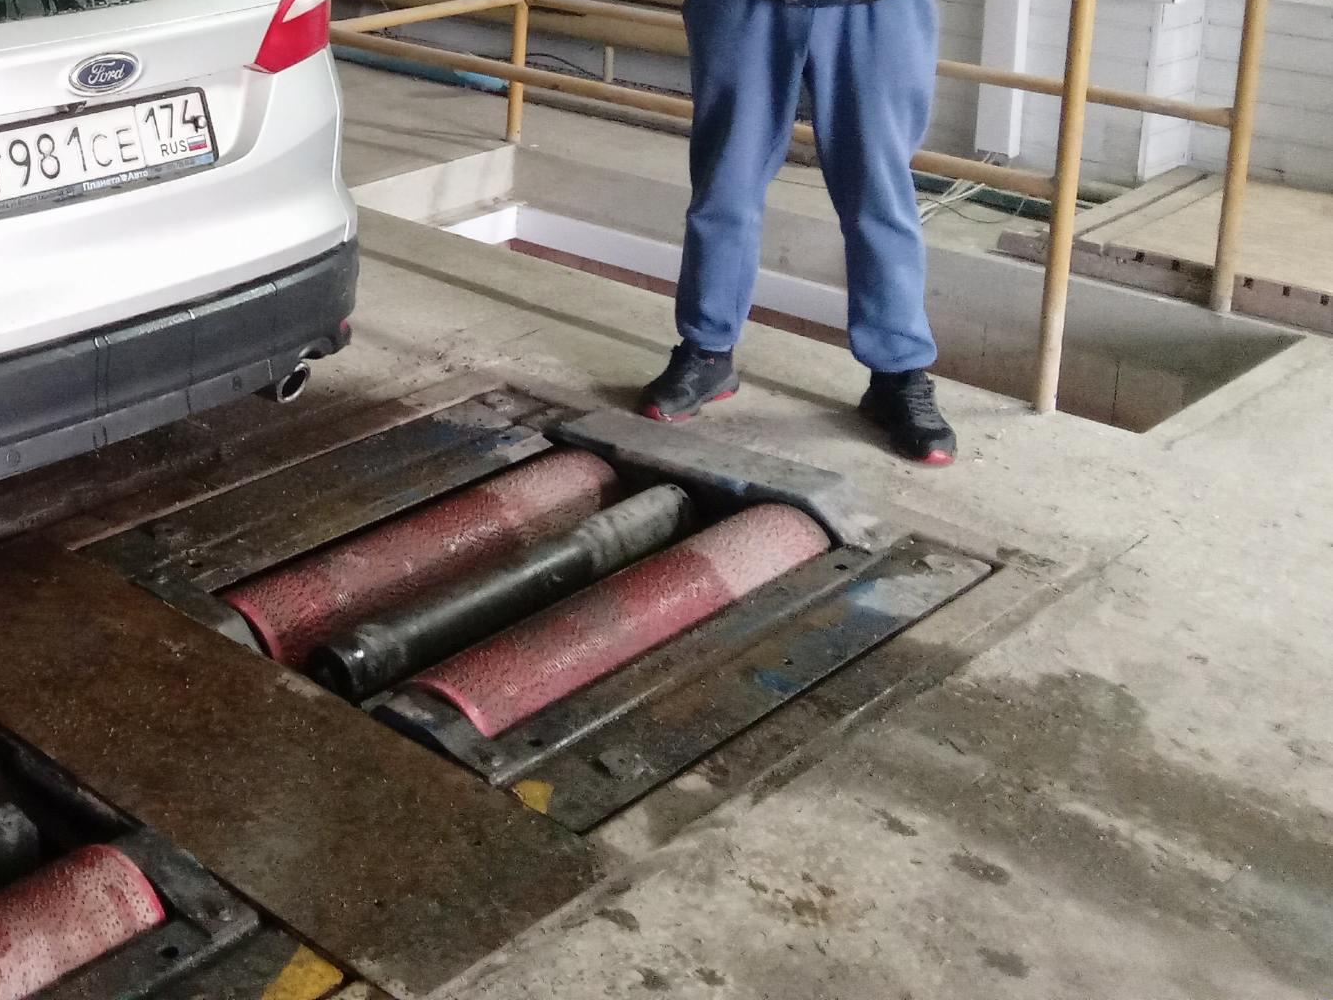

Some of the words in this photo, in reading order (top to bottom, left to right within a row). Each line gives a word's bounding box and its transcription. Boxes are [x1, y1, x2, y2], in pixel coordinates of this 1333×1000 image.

[88, 61, 125, 85] Ford
[145, 98, 200, 142] 174
[160, 140, 188, 157] RUS
